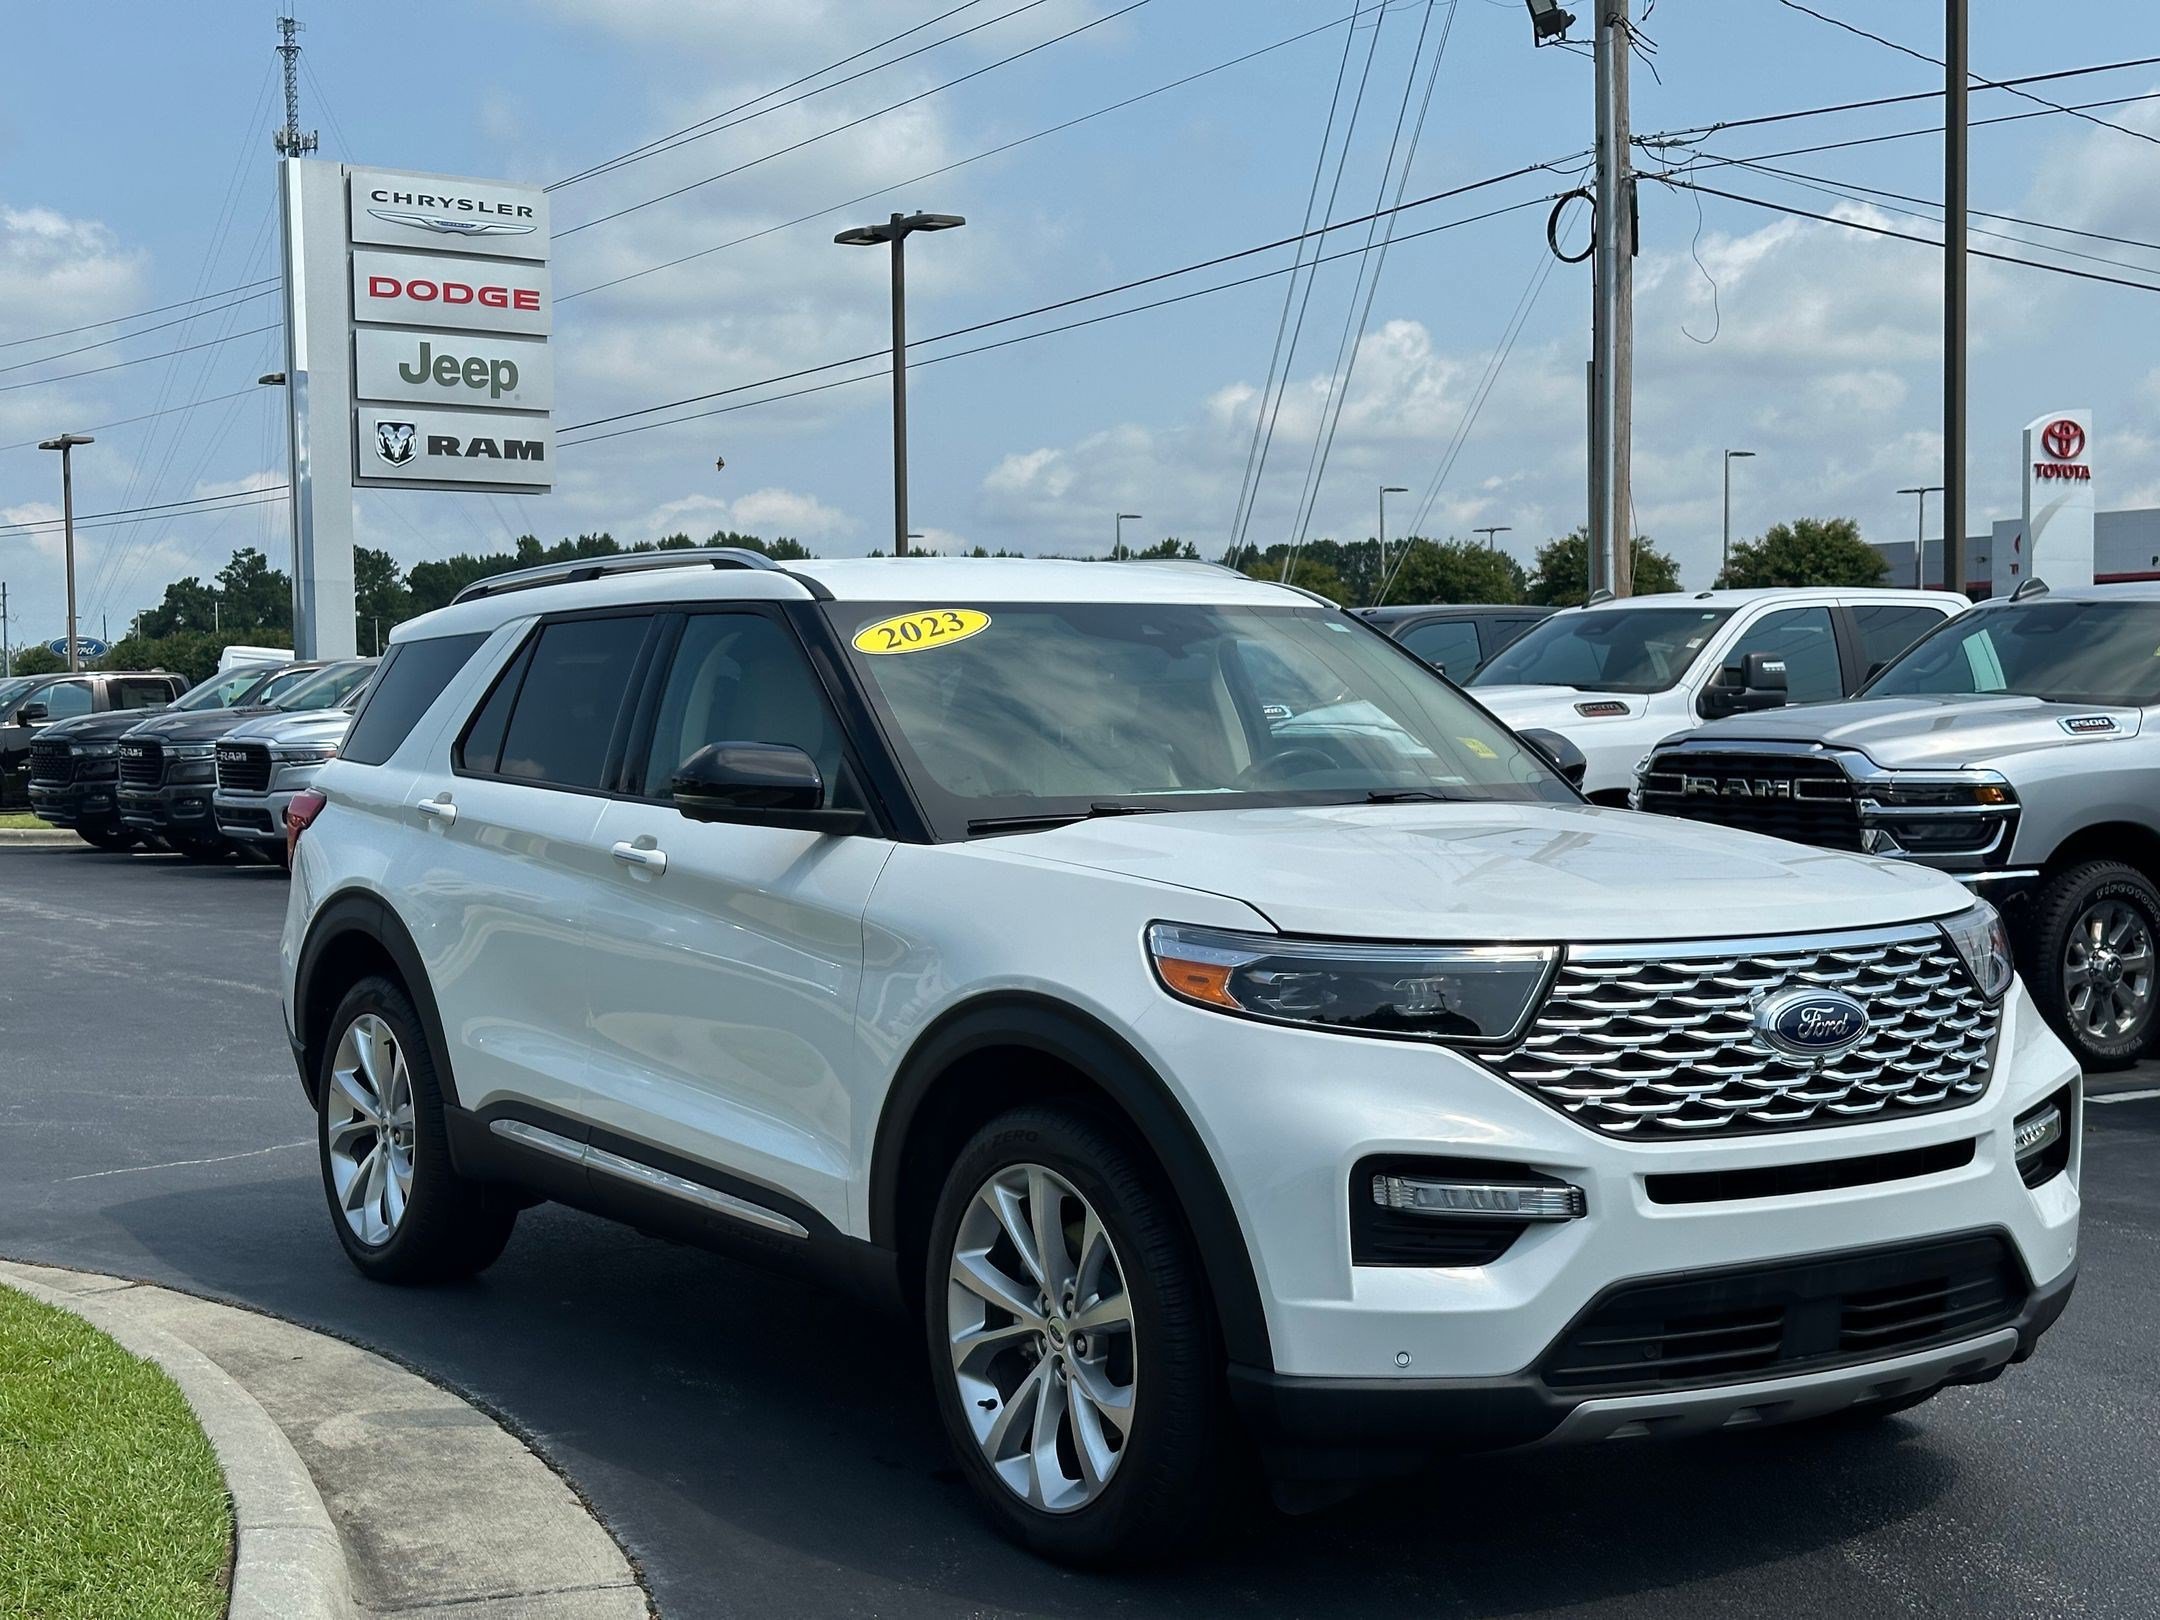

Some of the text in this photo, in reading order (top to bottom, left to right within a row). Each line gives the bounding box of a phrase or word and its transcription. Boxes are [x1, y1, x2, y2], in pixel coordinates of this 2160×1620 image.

[371, 189, 534, 218] CHRYSLER
[369, 276, 541, 311] DODGE
[399, 341, 519, 399] Jeep
[427, 435, 545, 461] RAM
[2033, 463, 2091, 480] TOYOTA
[877, 612, 965, 649] 2023
[2070, 719, 2109, 728] 2500
[120, 747, 143, 757] RAM
[220, 751, 247, 761] RAM
[1686, 776, 1790, 797] RAM
[1797, 1006, 1850, 1039] Ford
